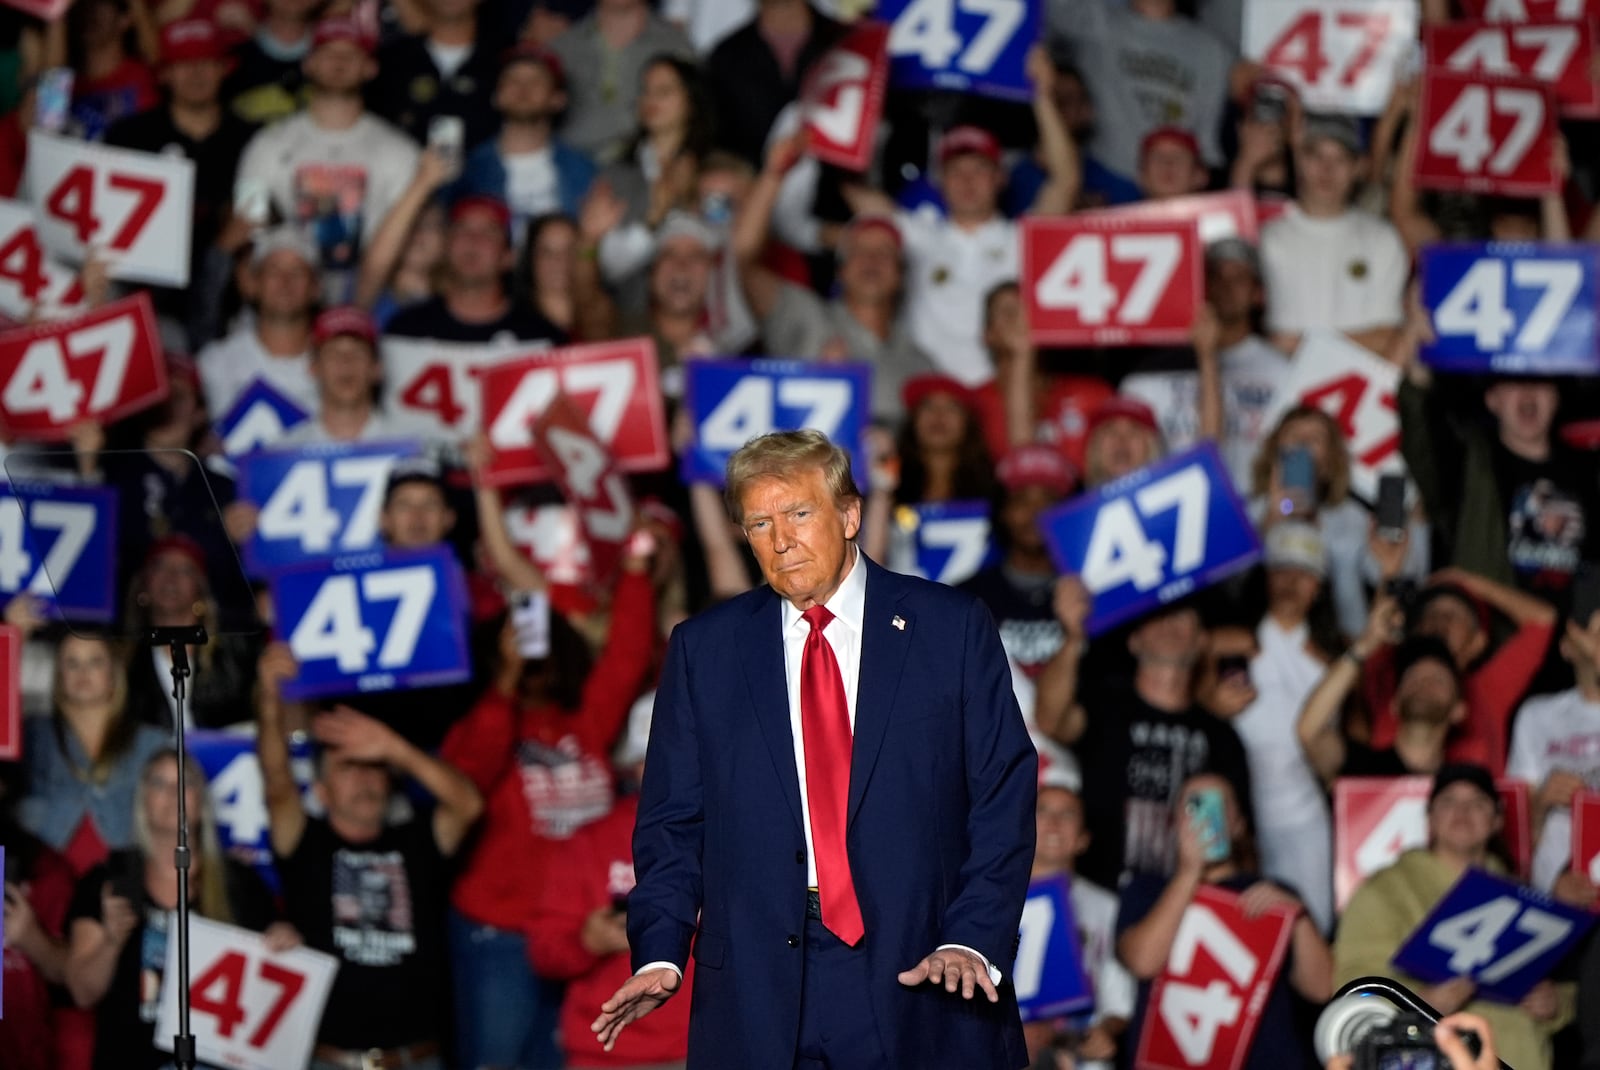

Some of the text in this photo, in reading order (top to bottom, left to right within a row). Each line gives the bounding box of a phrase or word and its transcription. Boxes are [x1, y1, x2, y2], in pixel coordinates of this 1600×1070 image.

[888, 0, 1026, 73] 47
[1260, 10, 1392, 88] 47
[1428, 84, 1545, 175] 47
[46, 165, 167, 253] 47
[1035, 234, 1183, 325] 47
[1433, 258, 1584, 350] 47
[2, 317, 136, 422] 47
[401, 363, 481, 425] 4
[702, 376, 851, 450] 47
[258, 456, 397, 553] 47
[1081, 463, 1210, 595] 47
[289, 566, 436, 672] 47
[1160, 903, 1260, 1066] 47
[1428, 896, 1573, 985] 47
[189, 949, 307, 1050] 47
